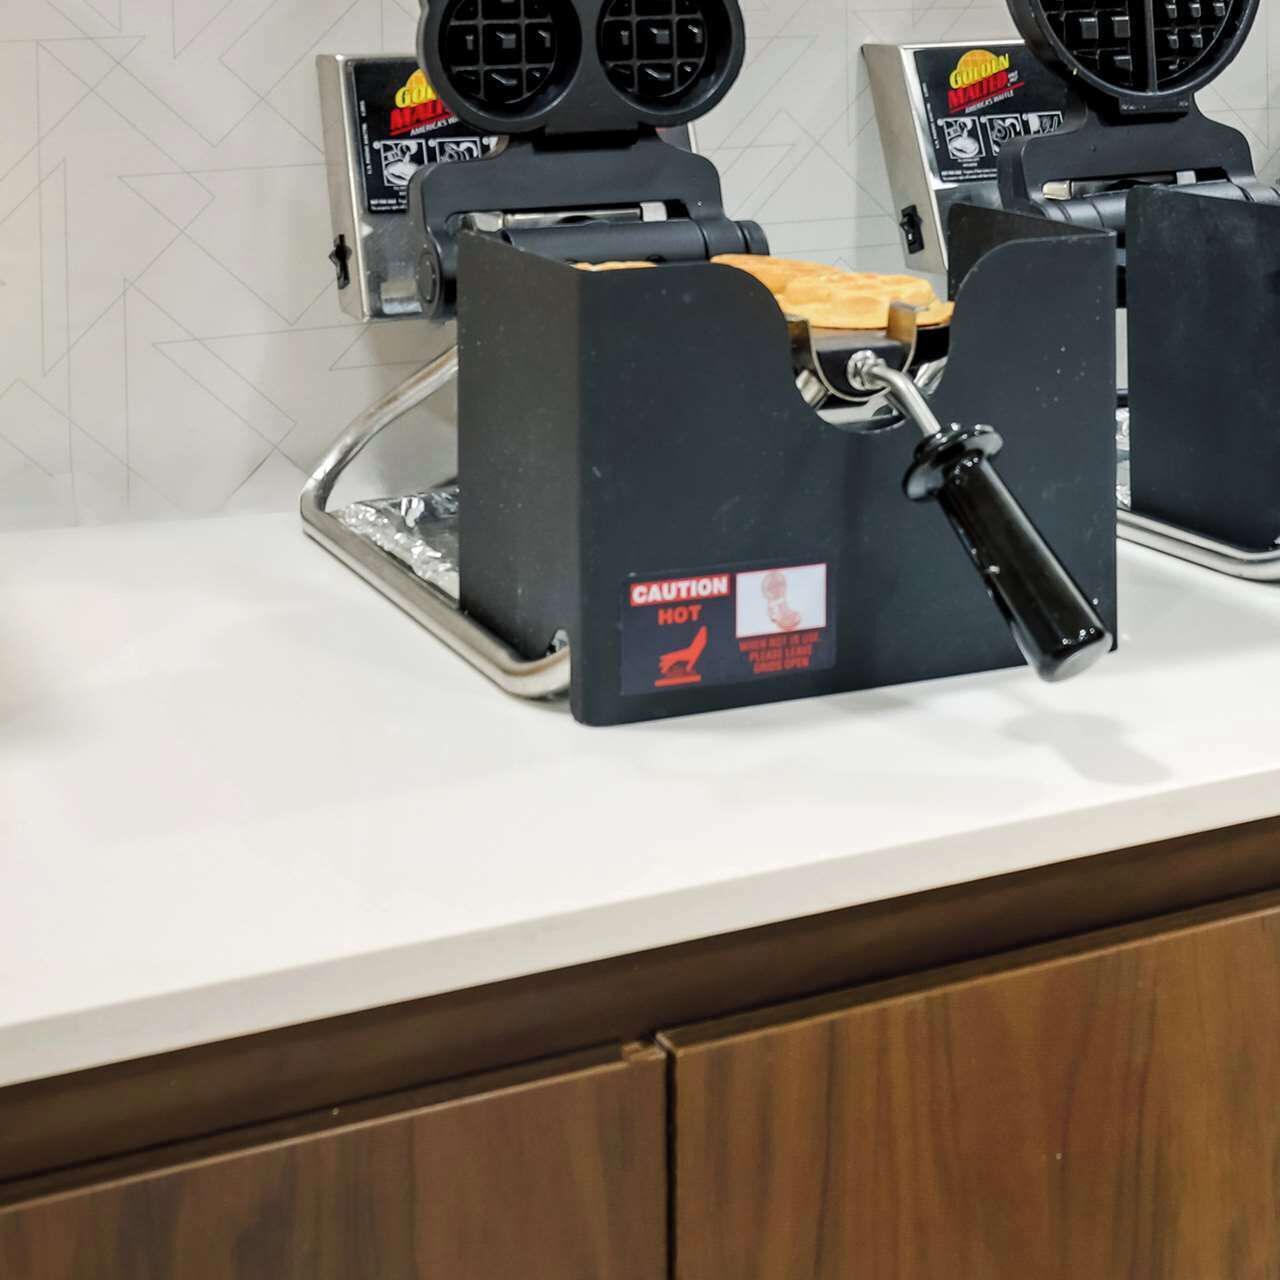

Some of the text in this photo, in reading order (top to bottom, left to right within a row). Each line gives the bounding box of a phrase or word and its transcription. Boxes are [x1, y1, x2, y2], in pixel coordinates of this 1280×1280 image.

[949, 52, 1010, 90] GOLDEN
[394, 85, 437, 109] GOL
[947, 70, 1009, 109] MALTED
[631, 577, 729, 604] CAUTION
[657, 604, 703, 625] HOT
